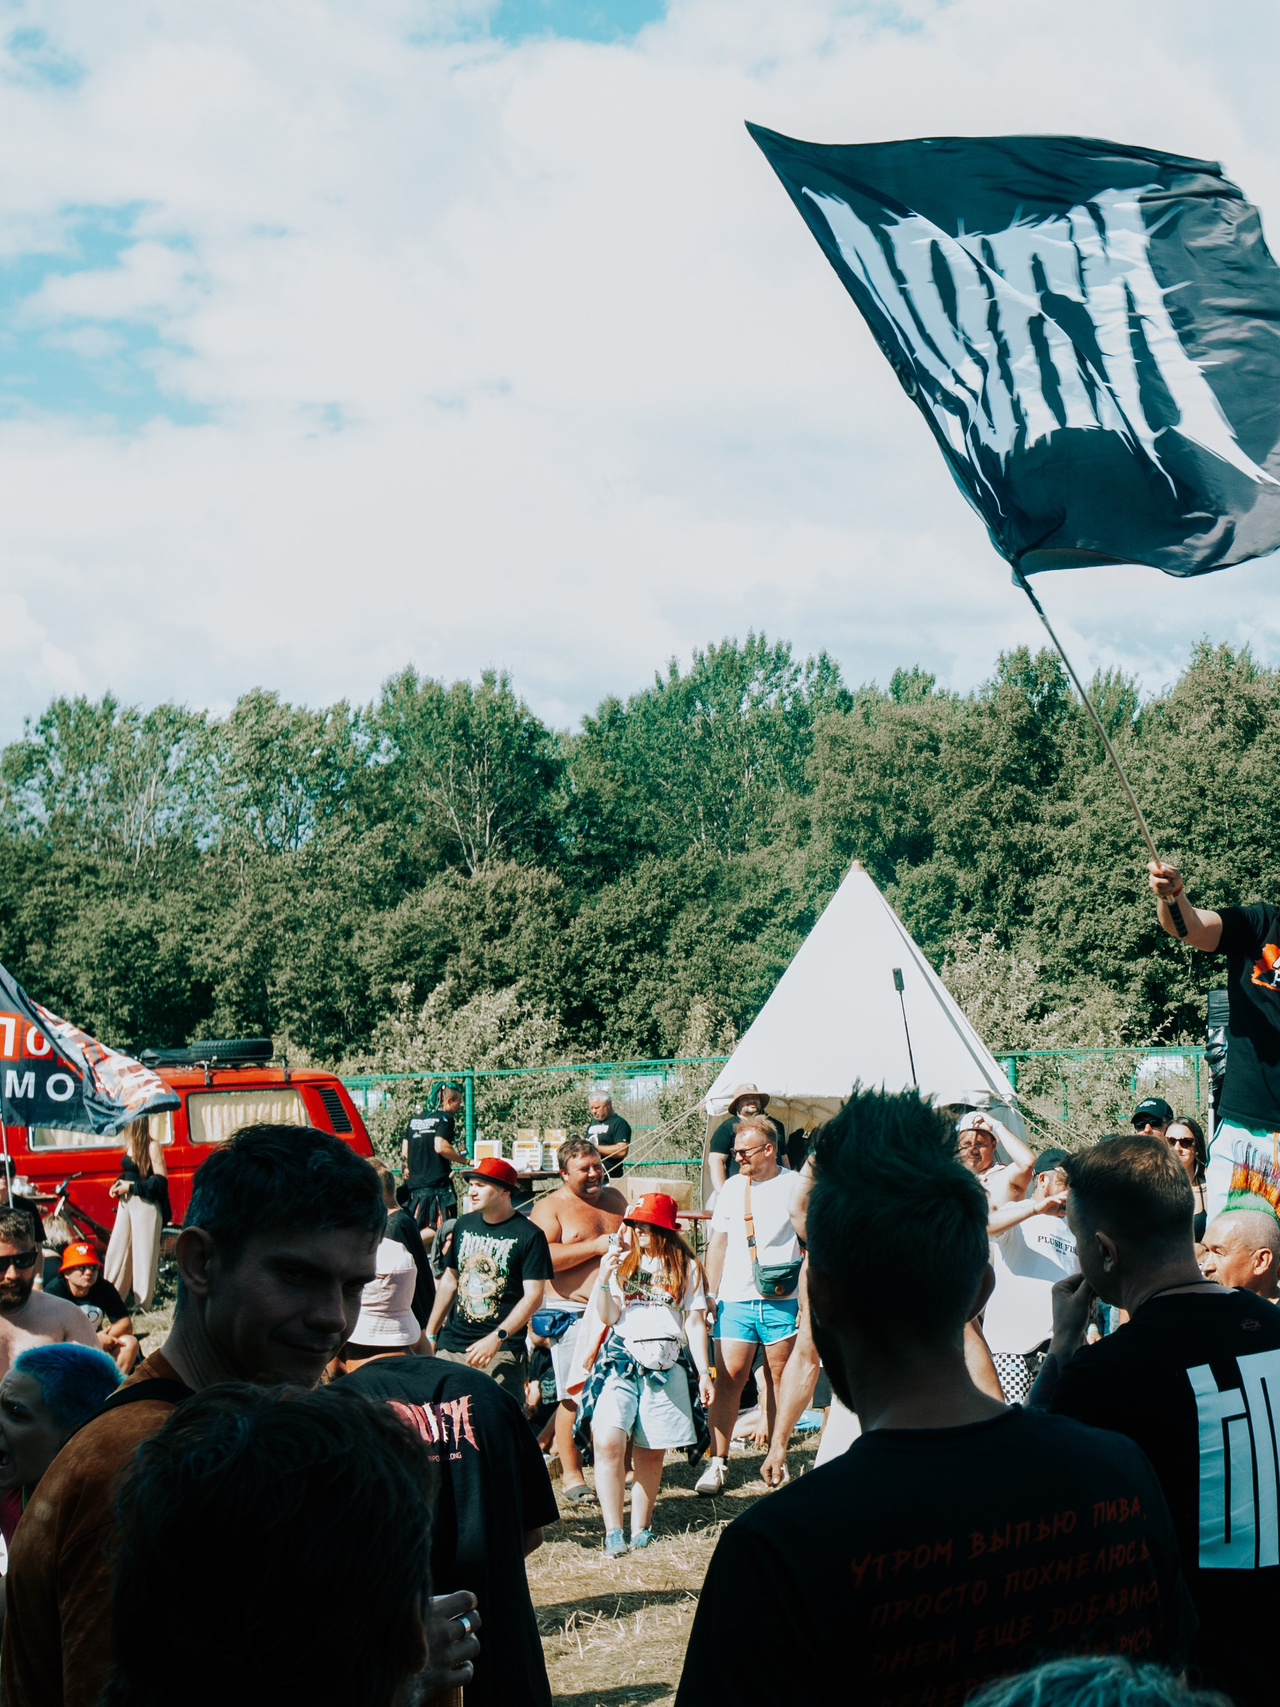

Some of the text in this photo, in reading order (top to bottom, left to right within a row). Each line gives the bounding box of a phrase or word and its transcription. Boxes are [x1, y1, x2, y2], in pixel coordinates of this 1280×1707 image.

[1037, 1235, 1063, 1249] PLUSH
[1064, 1243, 1079, 1256] FIS
[850, 1496, 1148, 1589] УТРОМ ВЫПЬЮ ПИВА,
[868, 1537, 1151, 1634] ПРОСТО ПОХМЕЛЮСЬ
[871, 1633, 958, 1678] ДНЕМ
[972, 1614, 1035, 1655] ЕЩЕ
